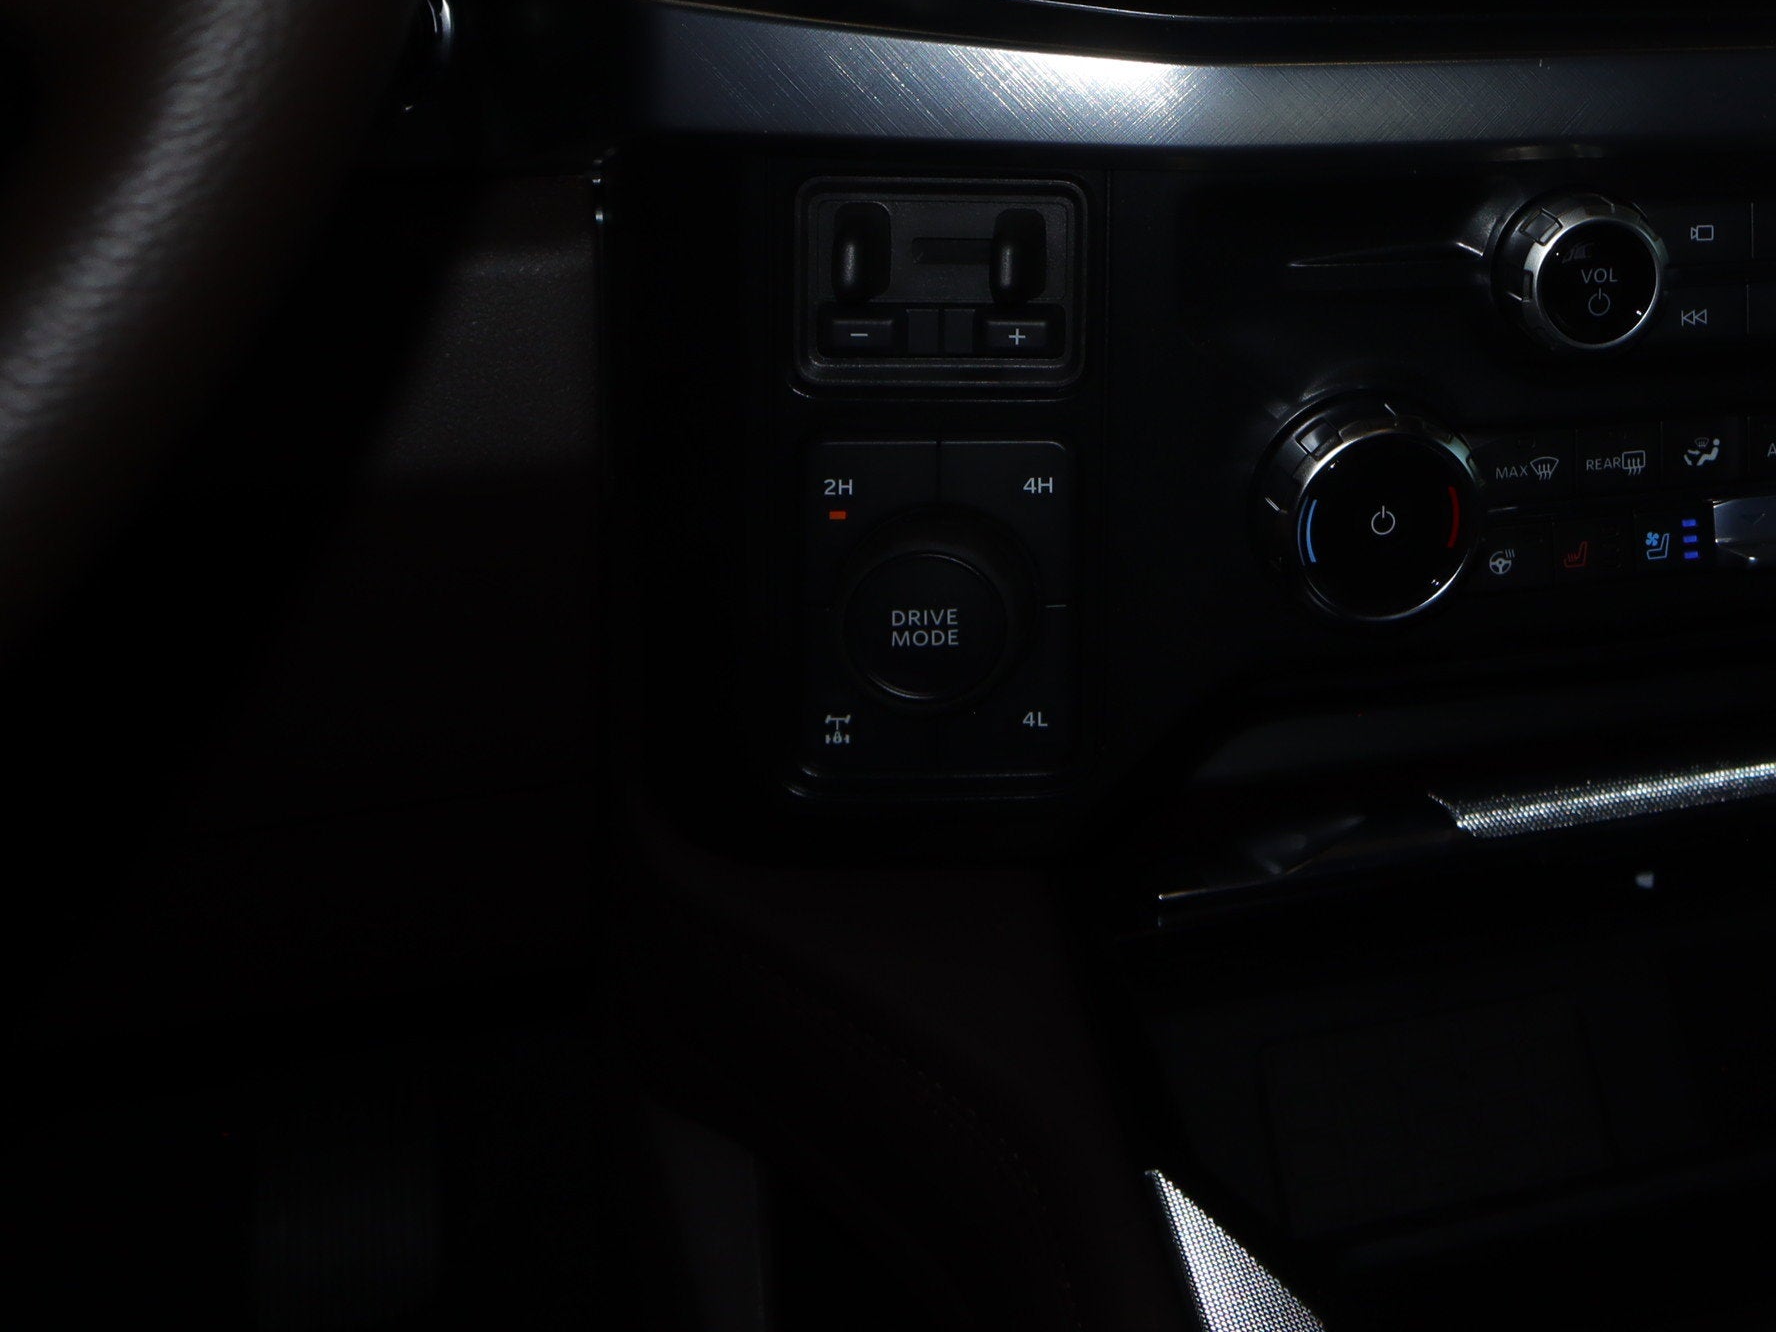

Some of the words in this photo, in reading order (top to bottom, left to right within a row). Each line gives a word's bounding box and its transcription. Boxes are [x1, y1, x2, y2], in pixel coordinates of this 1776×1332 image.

[1579, 268, 1619, 285] VOL
[1495, 465, 1529, 480] MAX
[1585, 456, 1622, 472] REAR
[822, 477, 854, 497] 2H
[1022, 476, 1054, 496] 4H
[891, 608, 959, 629] DRIVE
[891, 628, 960, 649] MODE
[1022, 710, 1049, 729] 4L
